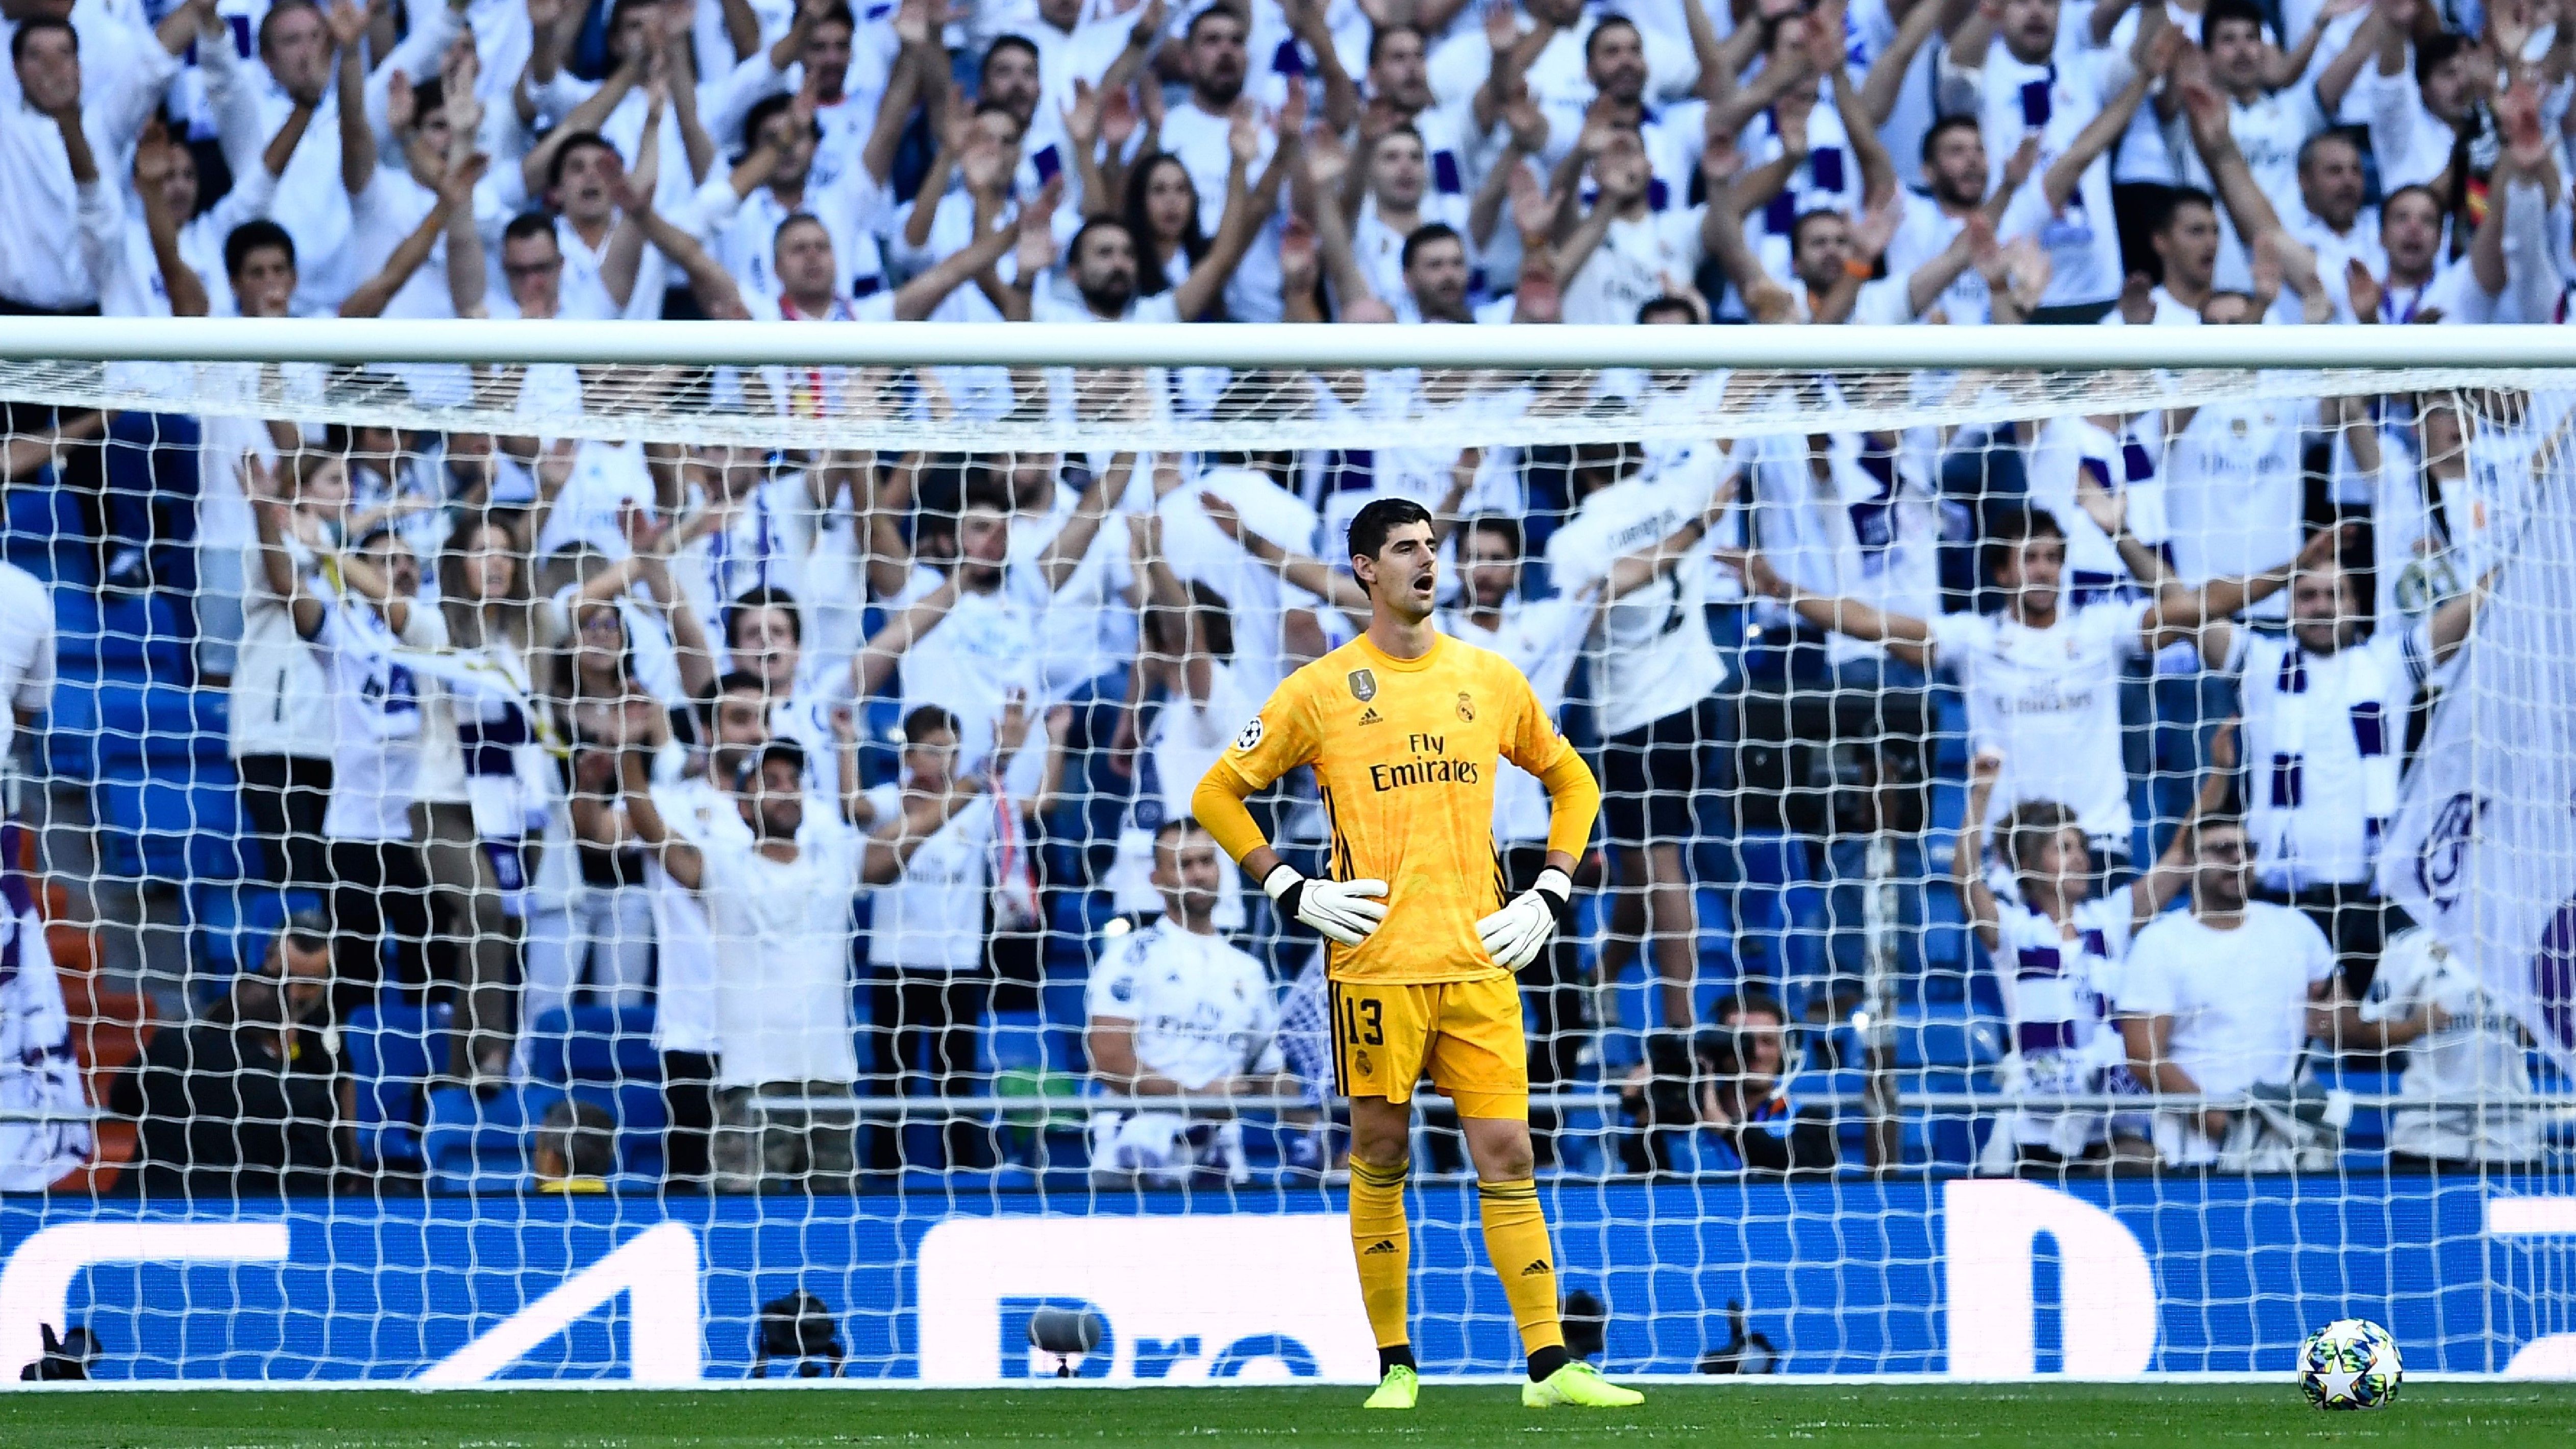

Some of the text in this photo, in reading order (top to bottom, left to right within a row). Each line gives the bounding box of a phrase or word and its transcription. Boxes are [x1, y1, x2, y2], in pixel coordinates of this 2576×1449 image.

[1409, 733, 1444, 755] Fly
[1369, 755, 1478, 792] Emirates
[1346, 997, 1383, 1045] 13
